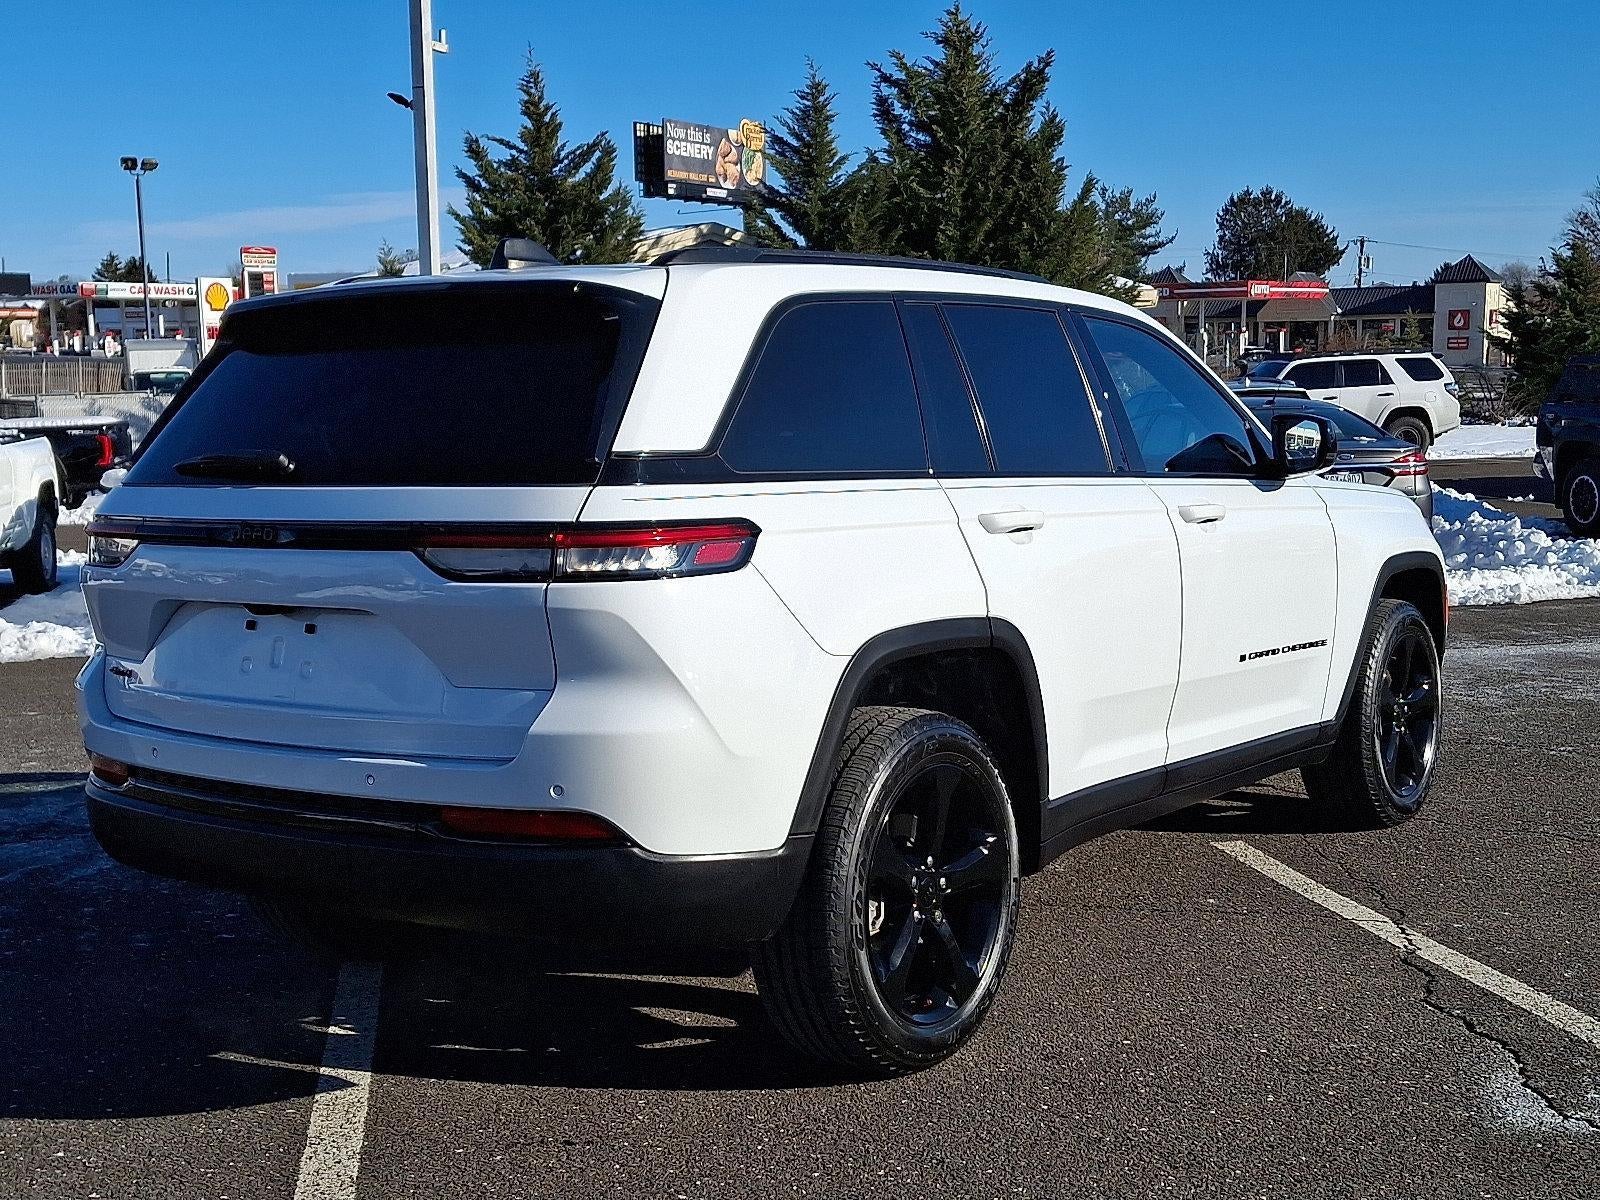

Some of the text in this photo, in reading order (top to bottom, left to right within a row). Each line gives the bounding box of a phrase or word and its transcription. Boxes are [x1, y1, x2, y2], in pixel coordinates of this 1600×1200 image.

[666, 122, 711, 144] Now this is
[666, 138, 714, 160] SCENERY
[32, 284, 77, 295] WASH GAS
[154, 286, 185, 297] WASH
[1248, 639, 1328, 661] GRAND CHEROKEE
